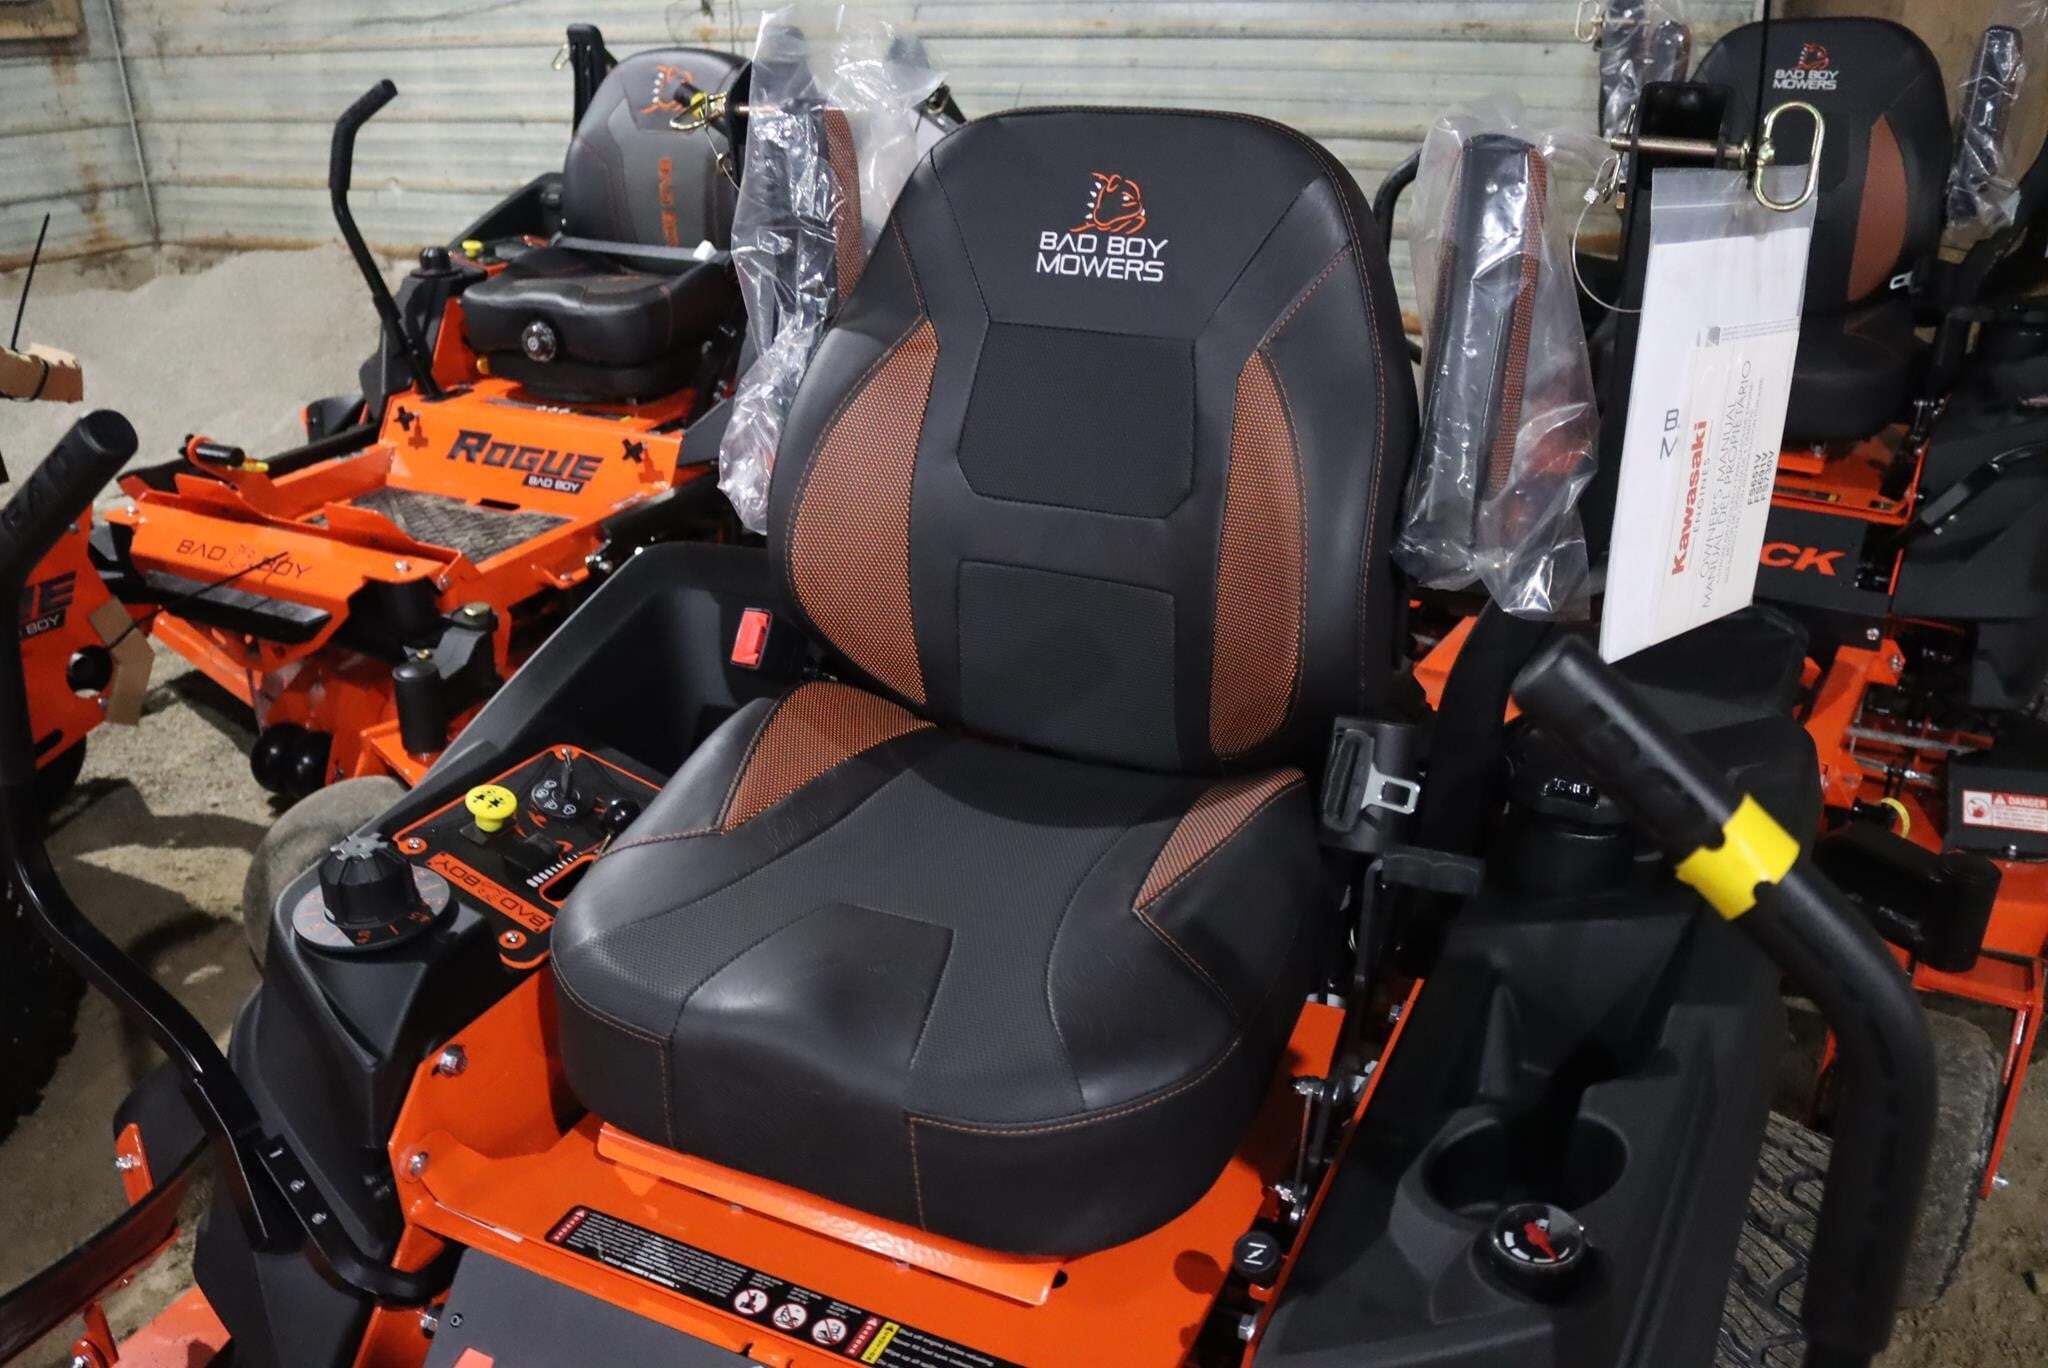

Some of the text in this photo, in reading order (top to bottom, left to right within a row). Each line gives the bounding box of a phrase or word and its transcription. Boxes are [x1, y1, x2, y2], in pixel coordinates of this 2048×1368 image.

[1772, 79, 1837, 90] MOWERS
[1775, 69, 1839, 80] BAD BOY
[1039, 231, 1168, 258] BAD BOY
[1036, 251, 1165, 282] MOWERS
[447, 429, 604, 482] ROGUE
[1716, 403, 1736, 482] MANUAL
[528, 475, 580, 492] BAD BOY
[1672, 420, 1706, 575] Kawasaki
[1693, 457, 1710, 533] ENGINES
[176, 539, 227, 561] BAD
[1702, 534, 1723, 608] MANUAL
[1715, 495, 1730, 527] DEL
[26, 614, 61, 636] BOY
[435, 861, 546, 927] BAD BOY
